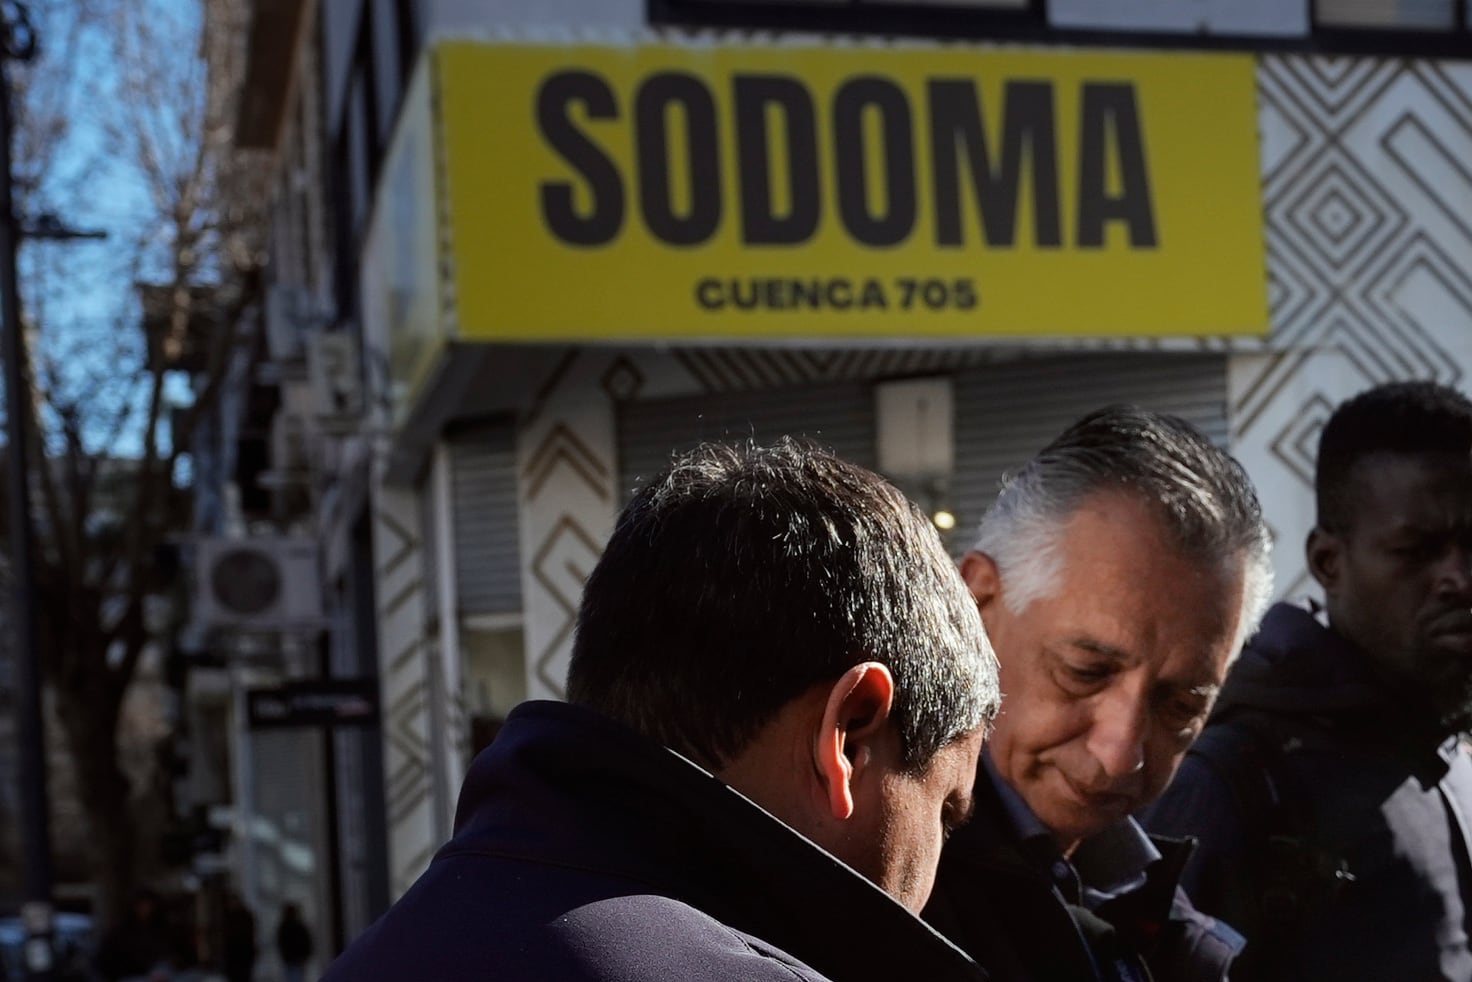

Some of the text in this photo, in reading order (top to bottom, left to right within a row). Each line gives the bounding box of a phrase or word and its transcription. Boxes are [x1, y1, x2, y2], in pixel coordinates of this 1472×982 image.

[534, 69, 1160, 249] SODOMA
[697, 277, 977, 311] CUENCA 705
